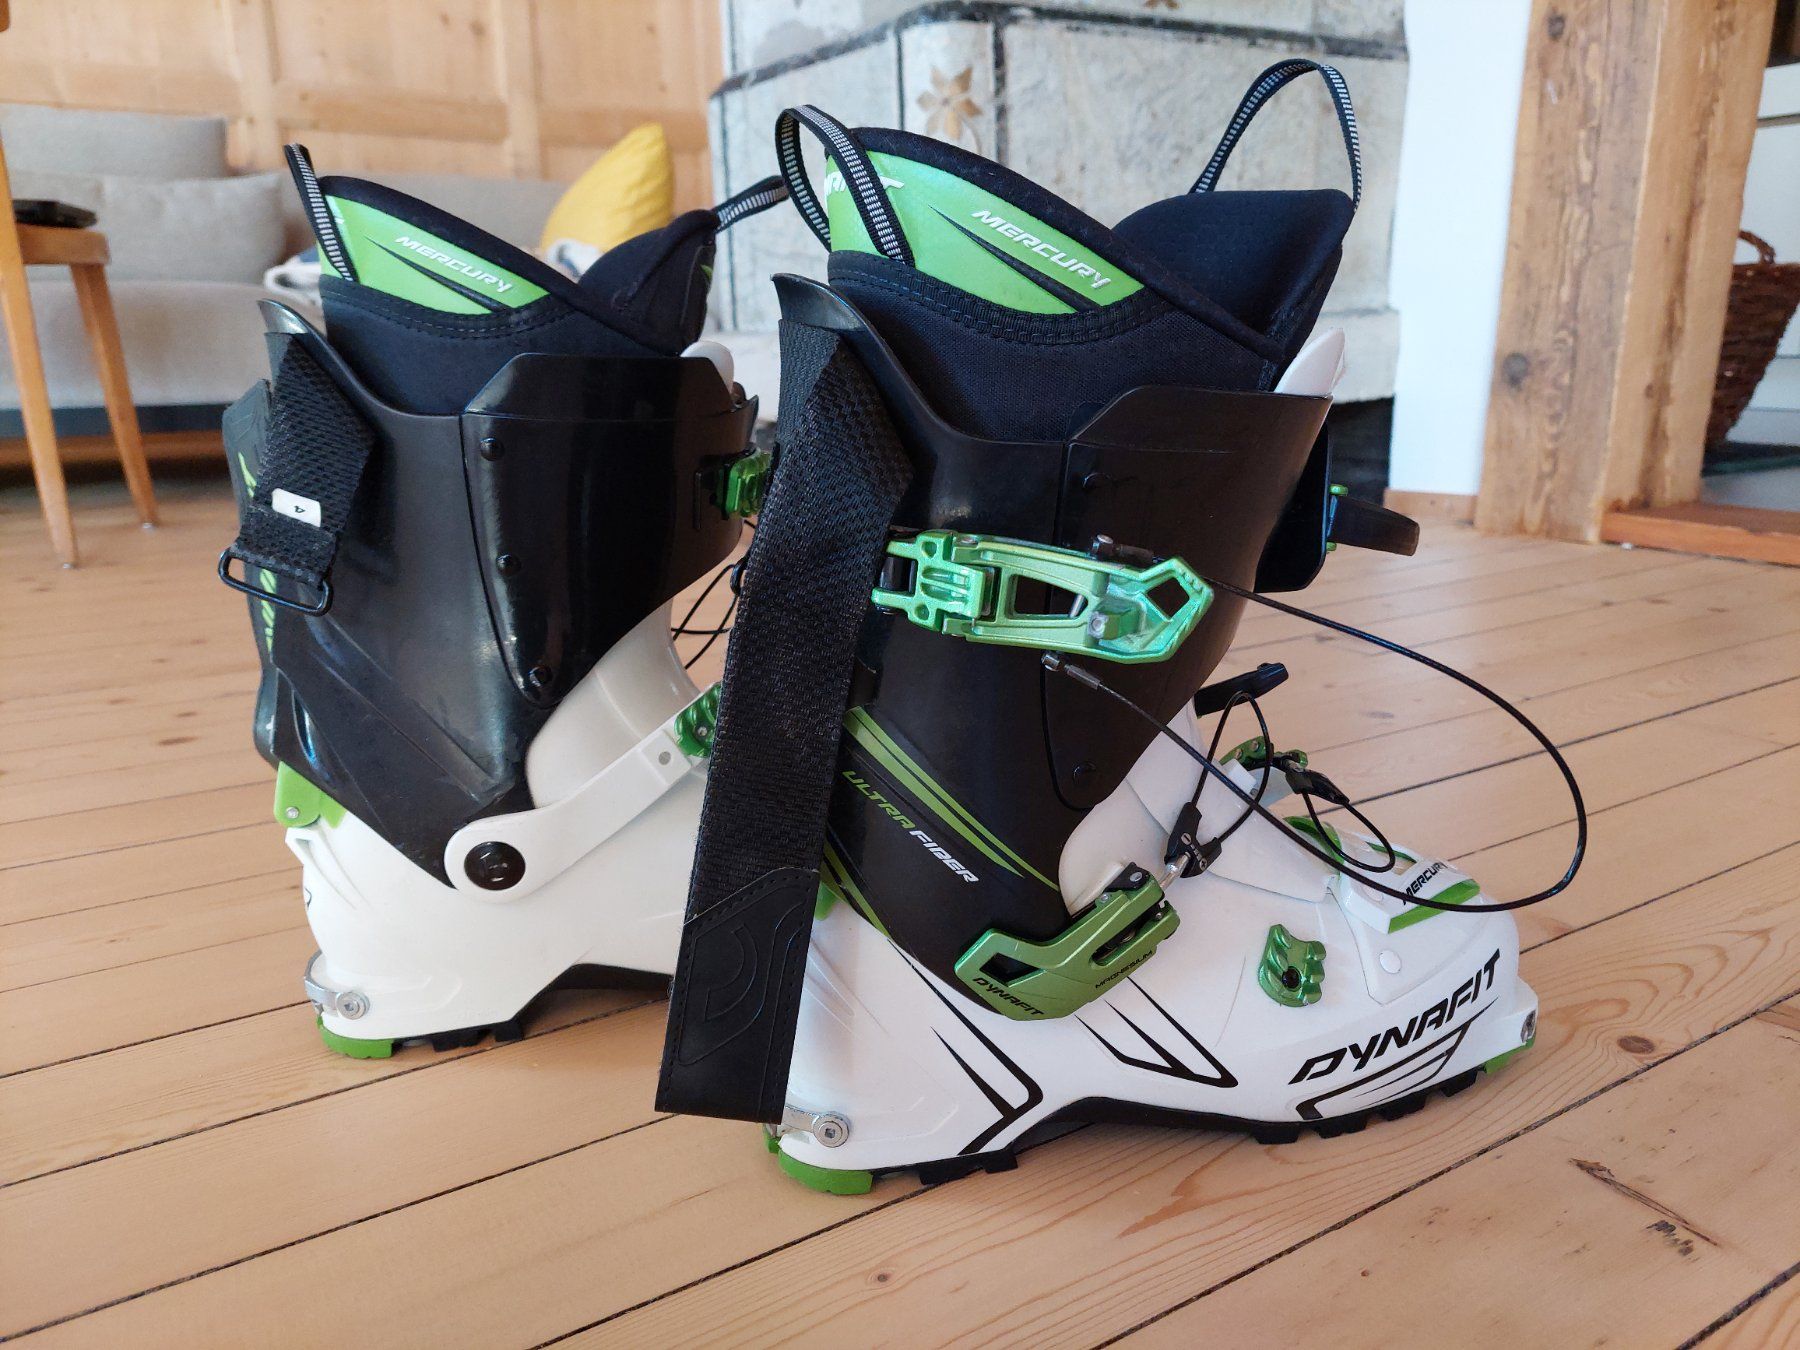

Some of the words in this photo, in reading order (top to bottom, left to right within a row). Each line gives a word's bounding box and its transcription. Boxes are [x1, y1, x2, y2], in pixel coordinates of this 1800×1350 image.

[395, 235, 513, 293] MERCURY
[971, 209, 1112, 289] MERCURY
[972, 977, 1045, 1016] DYNAFIT
[1095, 950, 1153, 989] MAGNESIUM
[1288, 948, 1501, 1085] DYNAFIT
